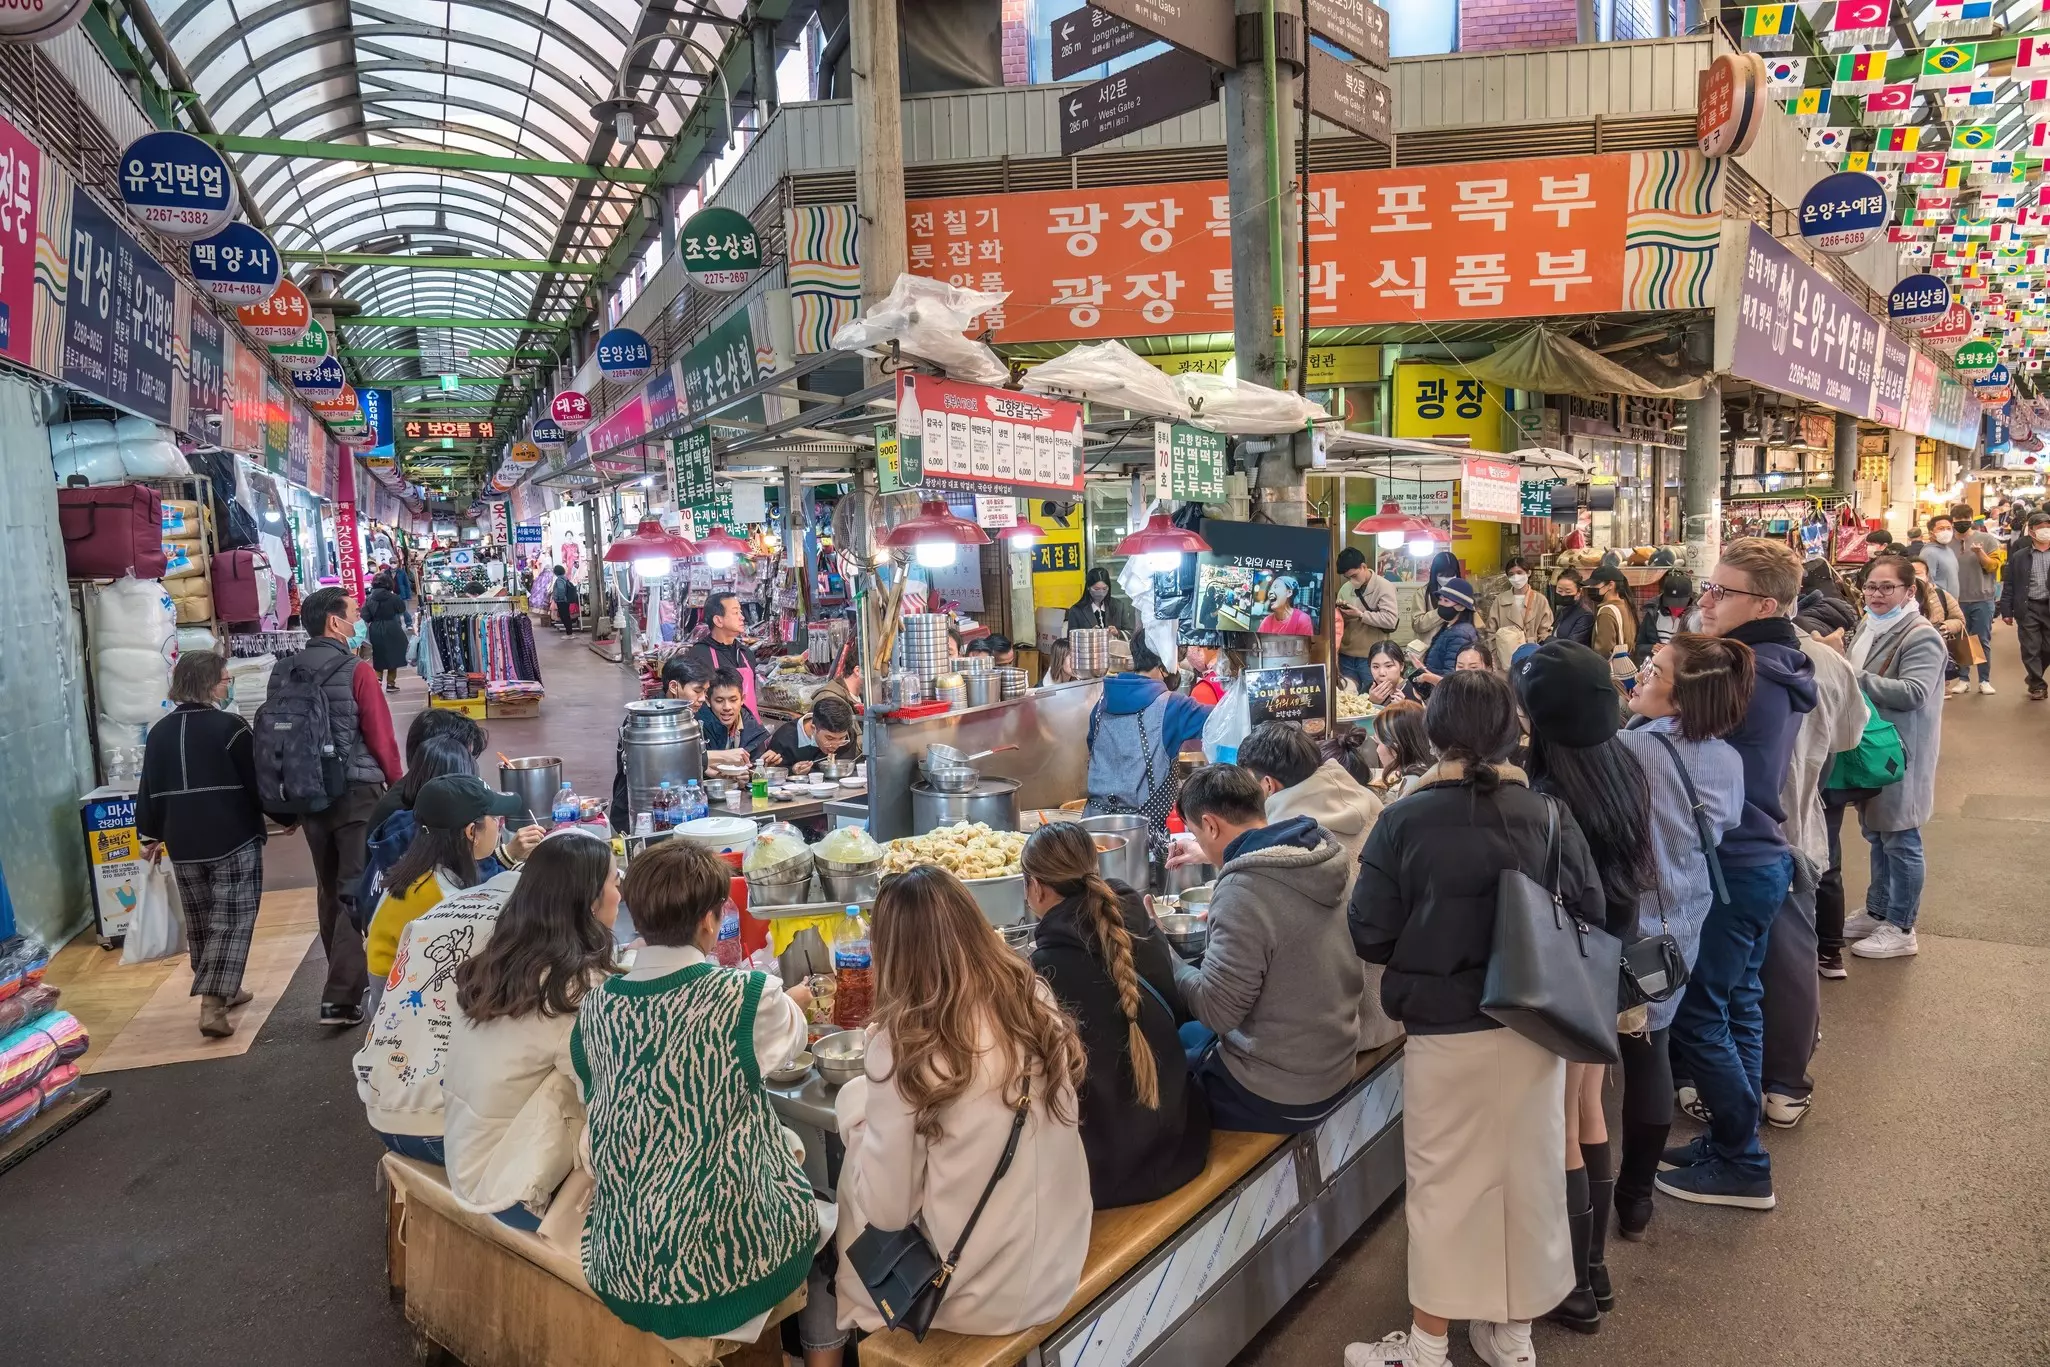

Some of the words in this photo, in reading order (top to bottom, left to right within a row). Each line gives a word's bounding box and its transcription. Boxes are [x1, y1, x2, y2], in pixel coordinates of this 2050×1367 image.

[1158, 2, 1176, 15] Gate
[1091, 25, 1119, 43] Jongno
[1061, 45, 1073, 58] 285
[1074, 41, 1082, 51] m
[1099, 78, 1128, 103] 서2문
[1346, 73, 1366, 98] 북2문
[1098, 107, 1117, 121] West
[1118, 100, 1135, 114] Gate
[1136, 96, 1141, 106] 2
[1069, 121, 1081, 134] 285
[1082, 118, 1089, 128] m
[124, 160, 223, 198] 유진면업
[145, 208, 209, 225] 2267-3382
[1803, 195, 1883, 223] 온양수예점
[685, 233, 758, 260] 조은상회
[1820, 232, 1865, 247] 2266-6369
[194, 243, 270, 275] 백양사
[74, 229, 113, 319] 대성
[704, 272, 749, 284] 2275-2697
[212, 281, 262, 295] 2274-4184
[1892, 288, 1946, 311] 일심상회
[132, 274, 173, 362] 유진면업
[1901, 314, 1936, 326] 2264-3845
[255, 328, 296, 336] 2267-1384
[1793, 279, 1862, 376] 온양수예점
[1928, 336, 1962, 345] 2279-7014
[281, 355, 316, 365] 2267-6249
[599, 344, 648, 363] 온양상회
[1956, 351, 1995, 365] 동명홍삼
[703, 335, 755, 403] 조은상회
[192, 349, 220, 410] 백양사
[1879, 366, 1904, 402] 일심상회
[556, 397, 587, 413] 대광
[1416, 378, 1488, 420] 광장
[996, 398, 1044, 422] 고향칼국수
[406, 422, 421, 437] 산
[428, 422, 471, 437] 보호를
[478, 422, 493, 437] 위
[926, 417, 943, 429] 칼국수
[534, 429, 565, 440] 미도꽃신
[1017, 432, 1032, 441] 수제비
[1178, 433, 1218, 449] 고향칼국수
[678, 434, 706, 453] 고향칼국수
[929, 457, 943, 466] 6,000
[976, 462, 989, 471] 6,000
[1160, 450, 1169, 467] 70
[685, 451, 696, 504] 떡만두
[702, 445, 714, 499] 칼만두
[998, 465, 1011, 474] 6,000
[1019, 468, 1031, 476] 6,000
[1039, 470, 1051, 478] 6,000
[1058, 473, 1070, 481] 5,000
[1173, 446, 1186, 497] 만두국
[1187, 447, 1200, 498] 떡만두
[1212, 450, 1225, 499] 칼만두
[676, 454, 687, 505] 만두국
[926, 478, 947, 489] 광장시장
[948, 480, 959, 489] 대표
[1161, 472, 1168, 488] 호
[680, 510, 691, 520] 70
[684, 523, 690, 531] 호
[1254, 689, 1286, 698] SOUTH
[1289, 685, 1321, 695] KOREA
[98, 818, 124, 829] 건강이
[1206, 1232, 1225, 1272] STAINLESS
[1126, 1314, 1147, 1358] STAINLESS
